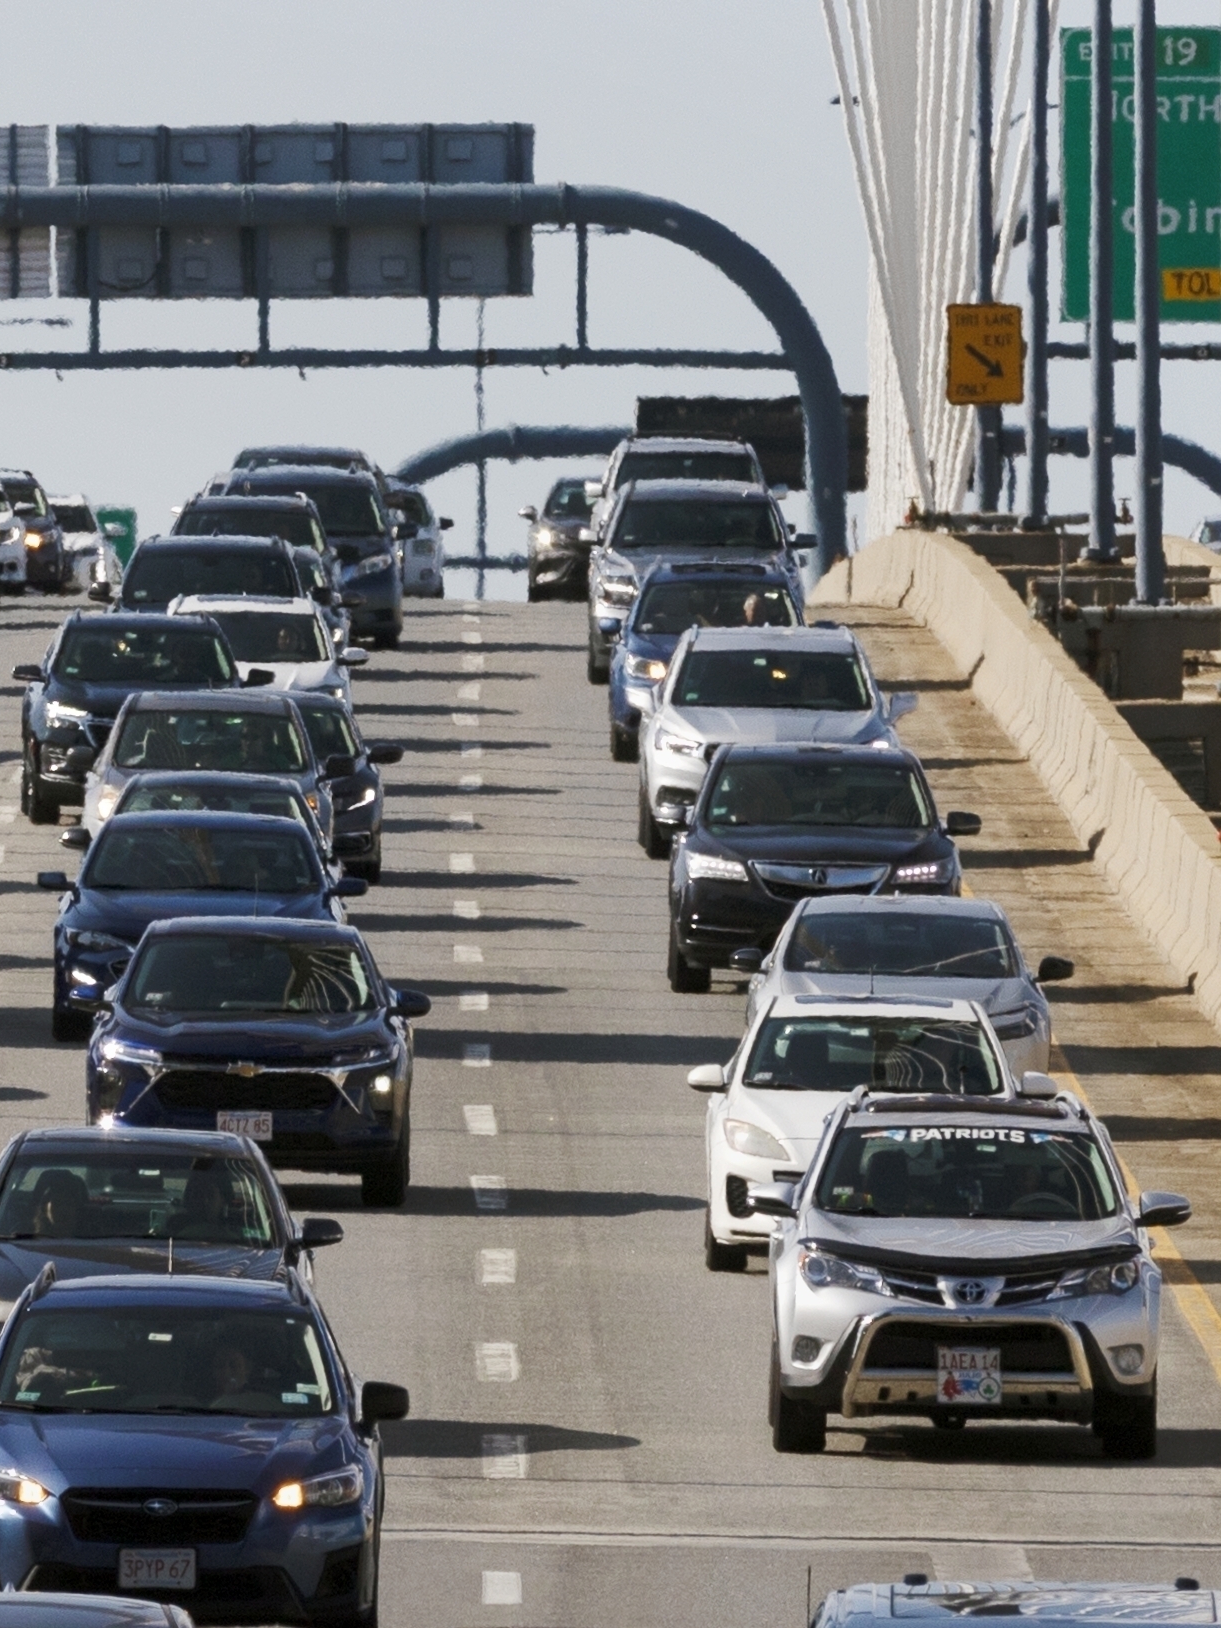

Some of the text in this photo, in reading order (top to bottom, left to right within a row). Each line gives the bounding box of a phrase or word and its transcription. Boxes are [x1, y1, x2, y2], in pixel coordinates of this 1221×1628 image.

[1079, 36, 1198, 66] EIT 19
[910, 1127, 1026, 1144] PATRIOTS
[123, 1559, 190, 1579] 3PYP 67
